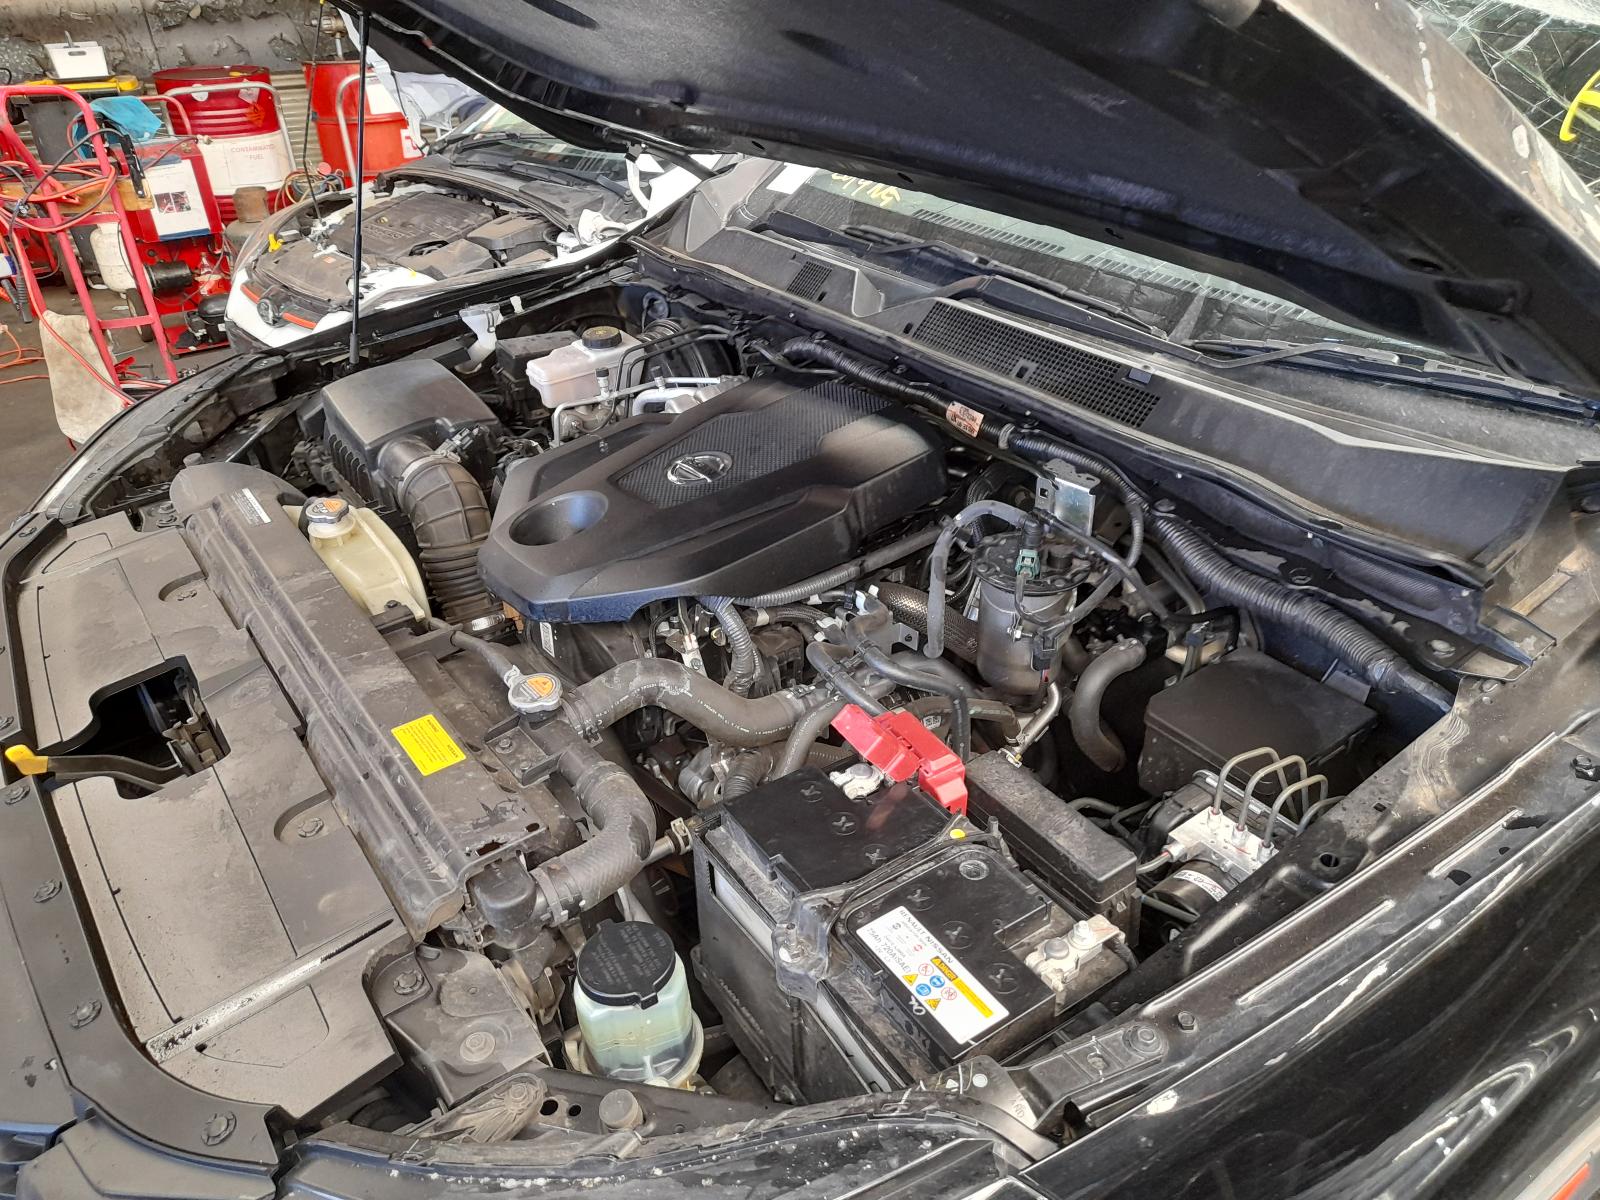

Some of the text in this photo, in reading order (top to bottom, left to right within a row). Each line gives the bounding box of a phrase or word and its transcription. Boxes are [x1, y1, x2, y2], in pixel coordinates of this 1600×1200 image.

[899, 909, 926, 935] RENAULT
[925, 935, 953, 963] NISSAN
[936, 962, 957, 981] DANGER
